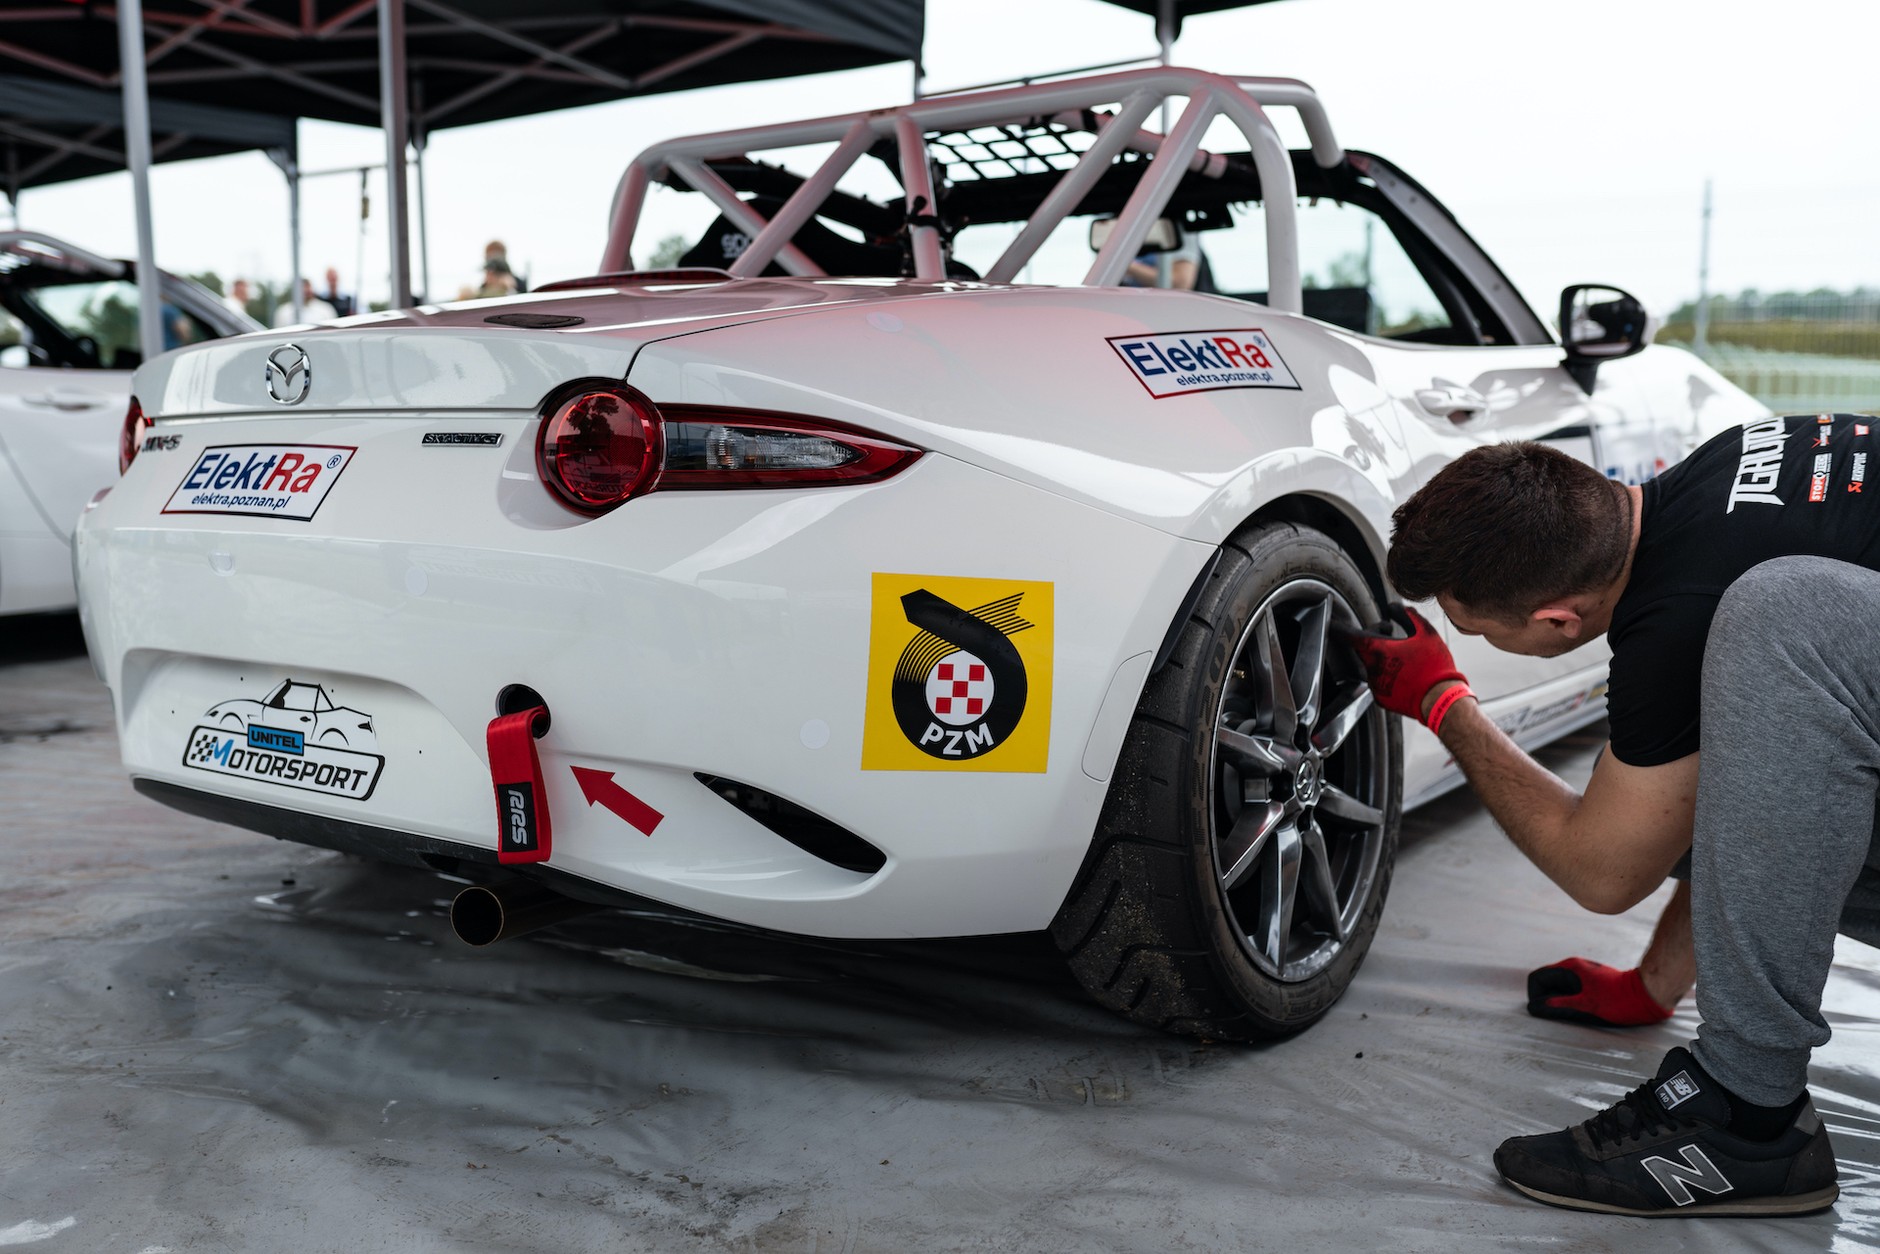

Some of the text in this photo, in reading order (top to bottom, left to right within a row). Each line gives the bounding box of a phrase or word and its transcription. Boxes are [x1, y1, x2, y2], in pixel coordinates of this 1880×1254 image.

[1176, 371, 1274, 386] elektra.poznan.pl
[191, 493, 292, 510] elektra.poznan.pl
[251, 730, 301, 750] UNITEL
[919, 721, 995, 756] PZM
[209, 738, 369, 791] MOTORSPORT
[508, 789, 528, 846] RRS
[1640, 1144, 1734, 1207] N
